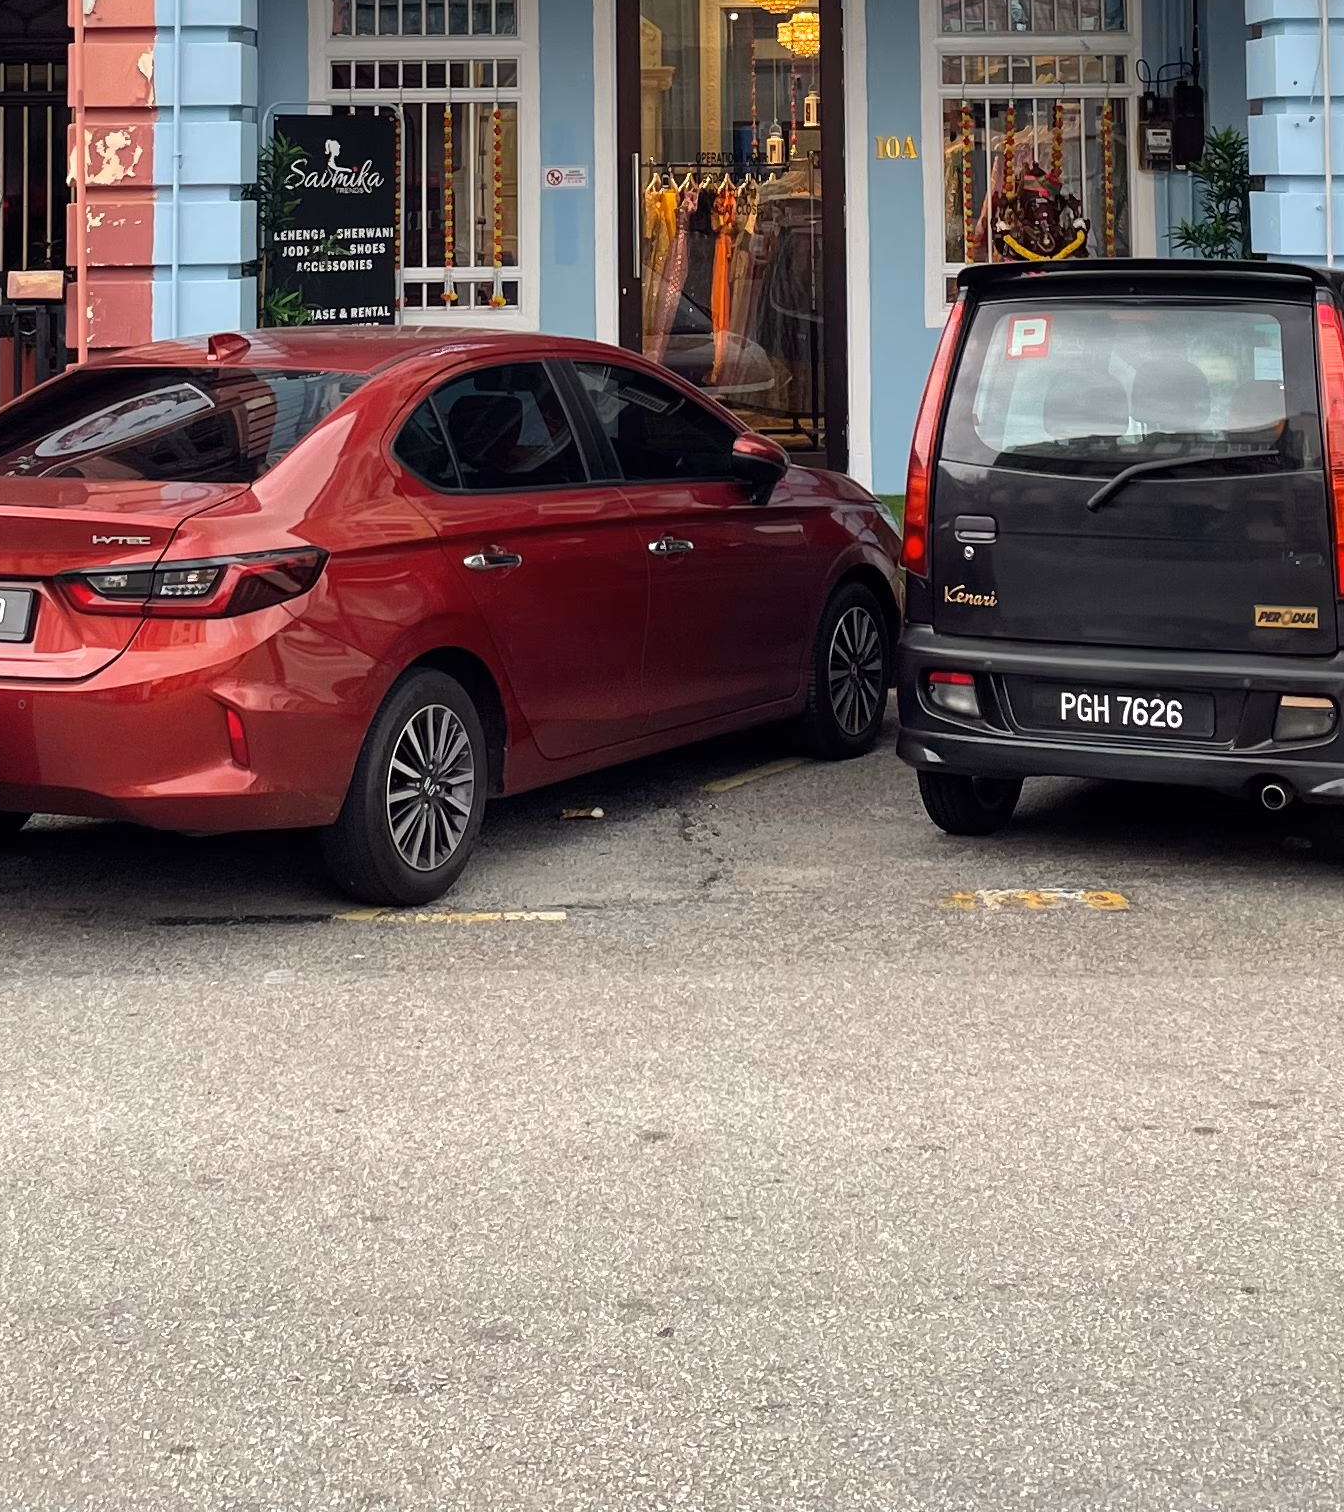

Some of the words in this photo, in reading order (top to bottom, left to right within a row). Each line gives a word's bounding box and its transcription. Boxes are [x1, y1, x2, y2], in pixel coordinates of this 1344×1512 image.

[875, 136, 919, 160] 10A
[273, 229, 326, 241] LEHENGA
[336, 227, 394, 239] SHERWANI
[349, 243, 386, 255] SHOES
[296, 259, 373, 272] ACCESSORIES
[339, 308, 348, 319] &
[350, 306, 391, 319] RENTAL
[1012, 318, 1047, 356] P
[944, 584, 998, 607] Kenari
[1258, 609, 1316, 626] PERODUA
[1060, 692, 1110, 724] PGH
[1117, 696, 1183, 728] 7626
